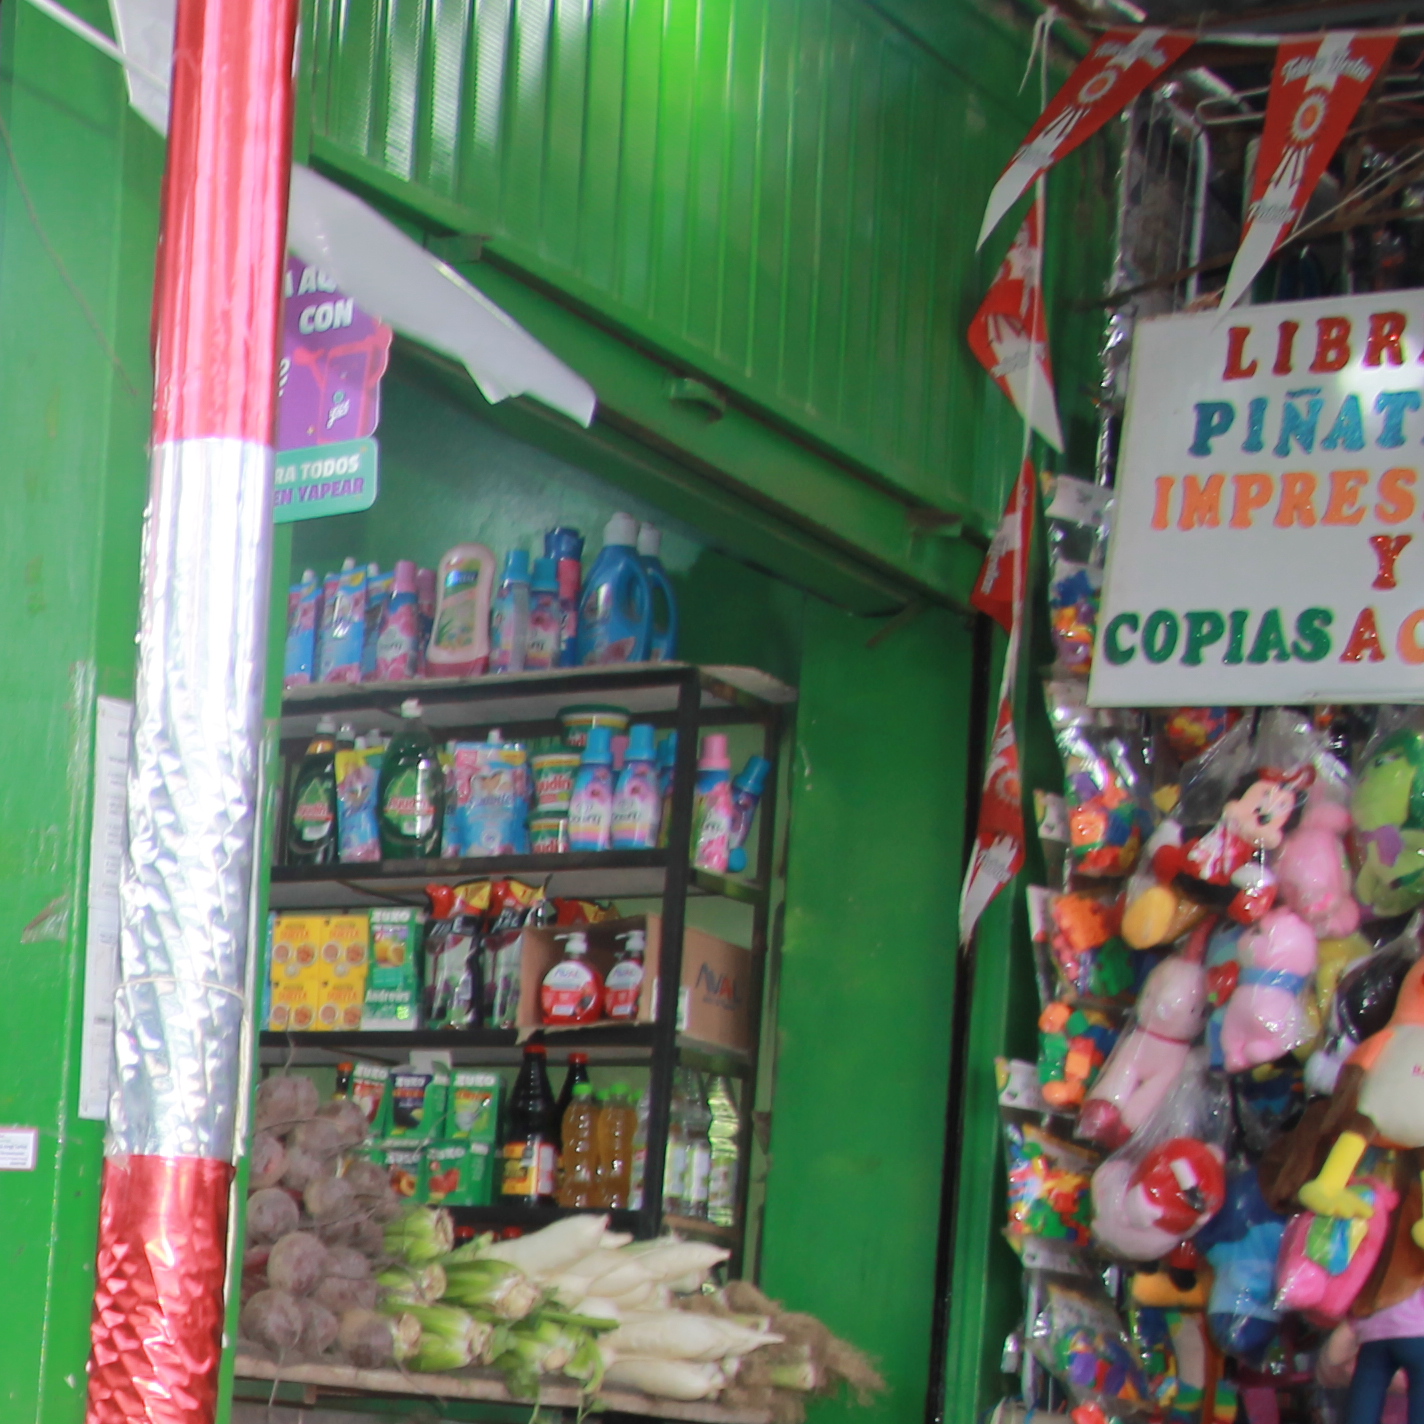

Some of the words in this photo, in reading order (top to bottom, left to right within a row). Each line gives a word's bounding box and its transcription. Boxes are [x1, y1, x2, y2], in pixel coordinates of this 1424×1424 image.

[299, 298, 354, 335] CON
[1223, 311, 1424, 381] LIBR
[1188, 386, 1424, 458] PIÑAT
[302, 452, 360, 481] TODOS
[1151, 466, 1424, 531] IMPRES
[1368, 534, 1412, 590] Y
[1103, 606, 1335, 667] COPIAS
[1338, 606, 1386, 664] A
